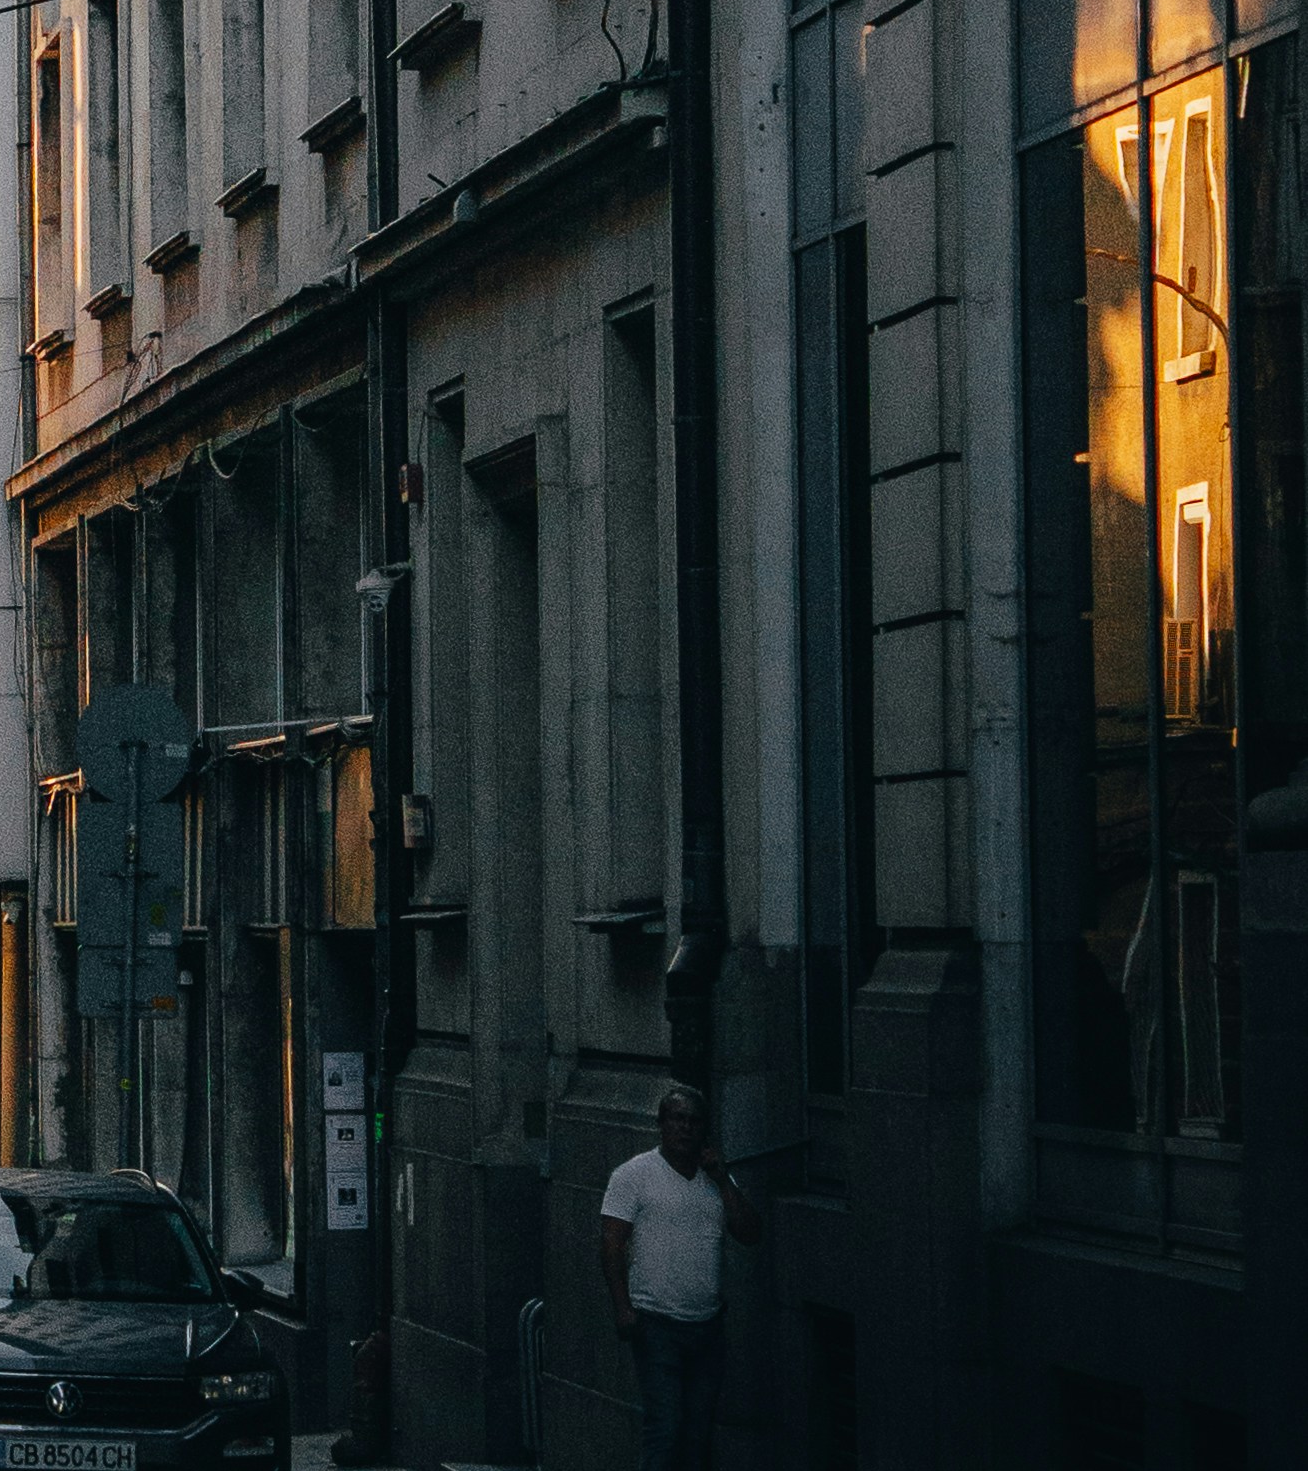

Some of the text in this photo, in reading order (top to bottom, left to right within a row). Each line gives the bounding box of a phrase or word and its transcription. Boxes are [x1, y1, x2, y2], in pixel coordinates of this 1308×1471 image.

[9, 1443, 132, 1469] CB 8504 CH
